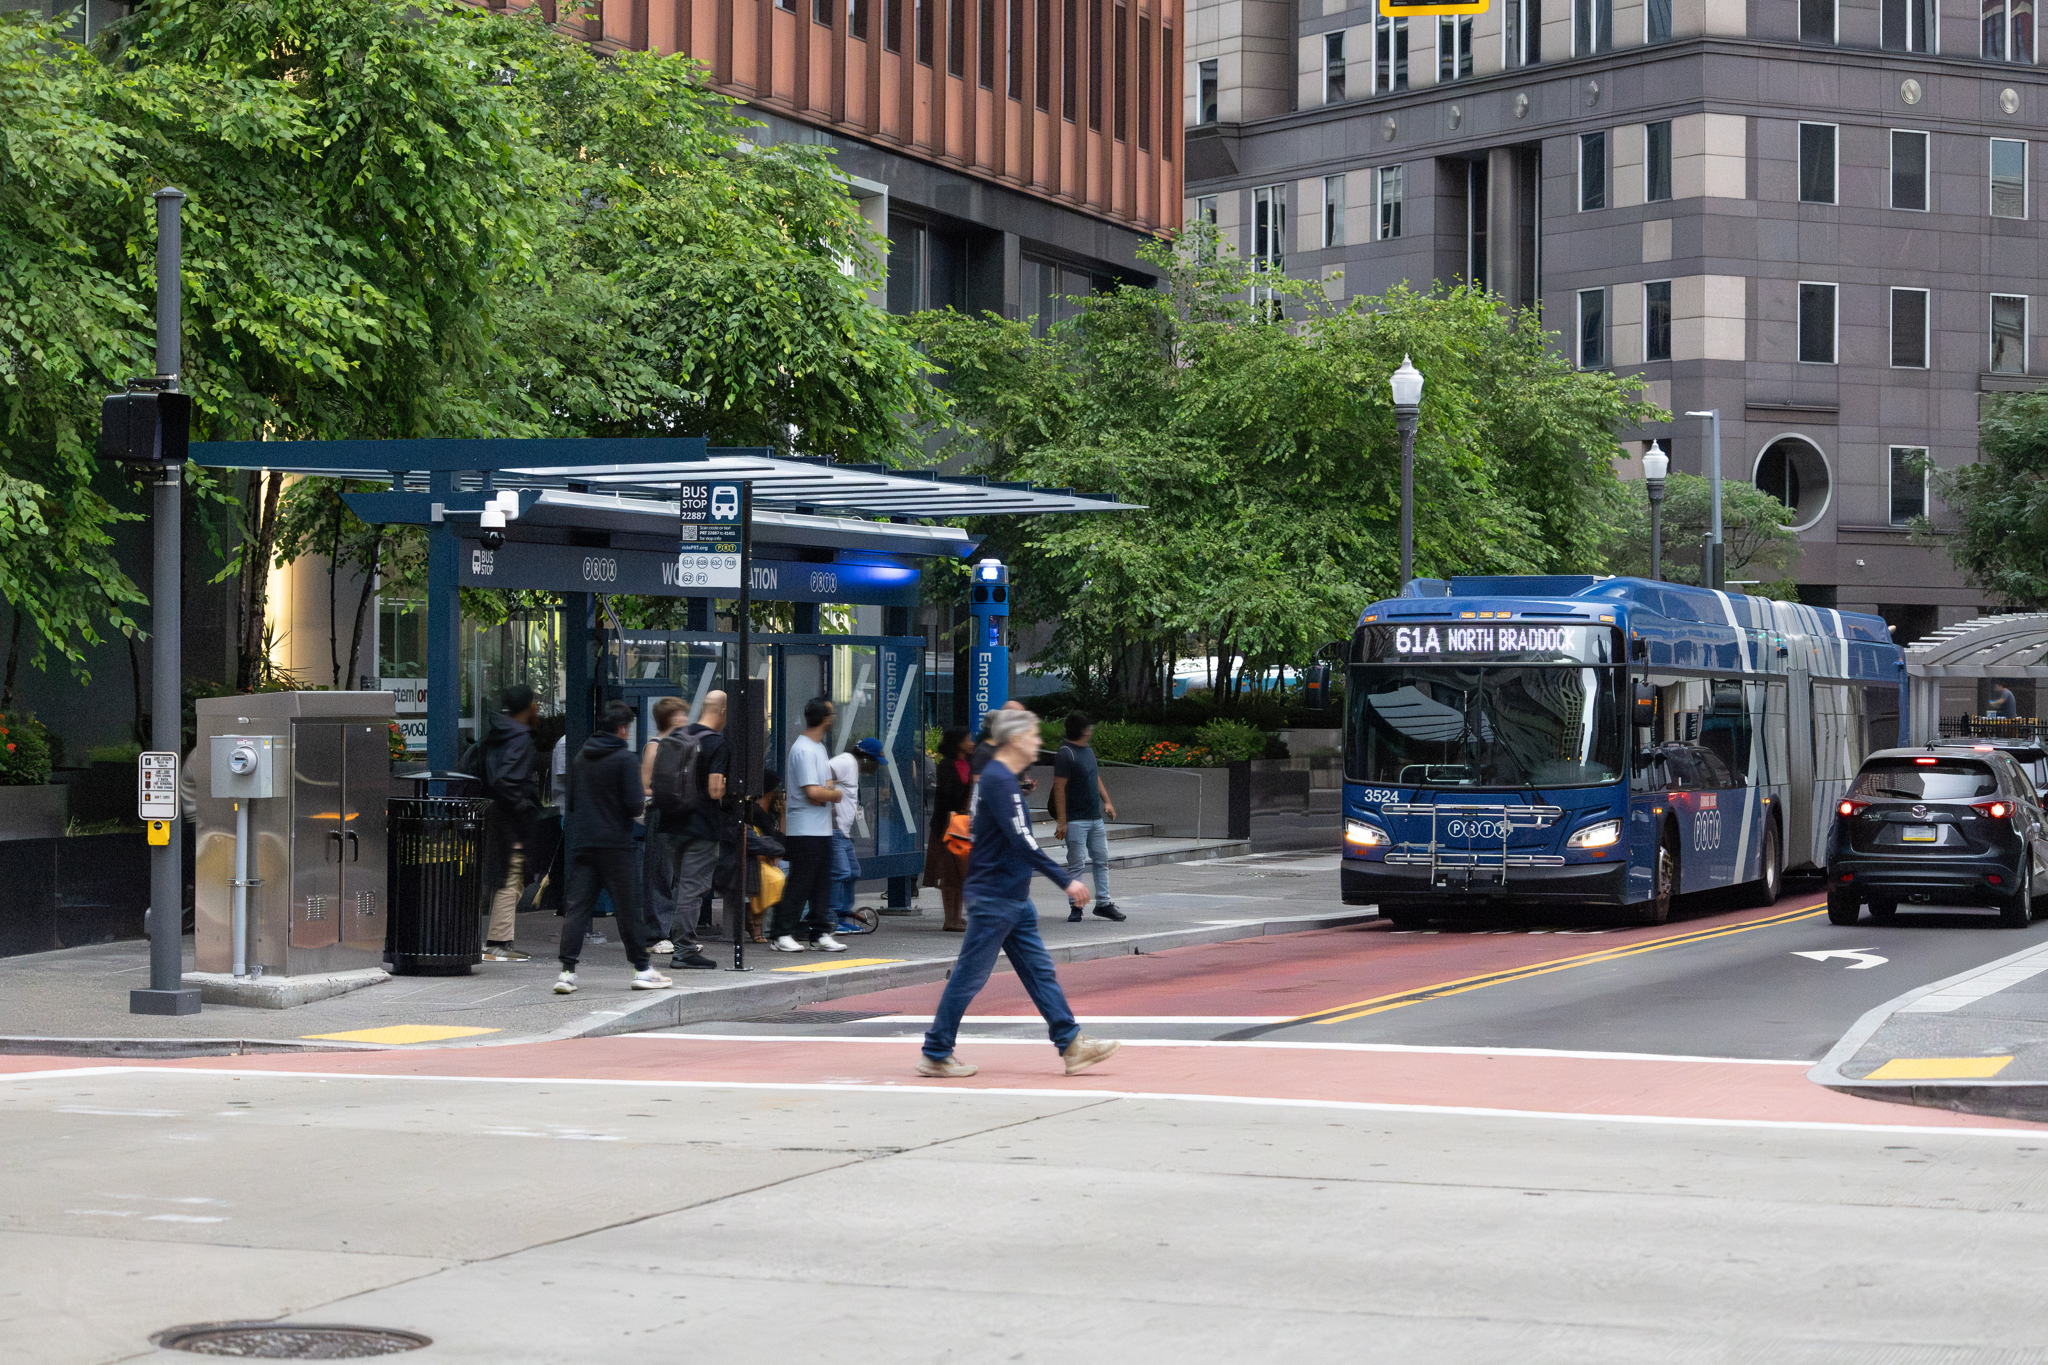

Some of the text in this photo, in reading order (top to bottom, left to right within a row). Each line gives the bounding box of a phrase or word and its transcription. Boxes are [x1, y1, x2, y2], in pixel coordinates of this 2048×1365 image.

[682, 486, 708, 498] BUS
[682, 499, 708, 509] STOP
[681, 511, 707, 520] 22887
[481, 550, 494, 564] BUS
[480, 564, 494, 576] STOP
[583, 558, 617, 580] PRTX
[1395, 627, 1576, 653] 61A NORTH BRADDOCK
[1364, 789, 1400, 803] 3524
